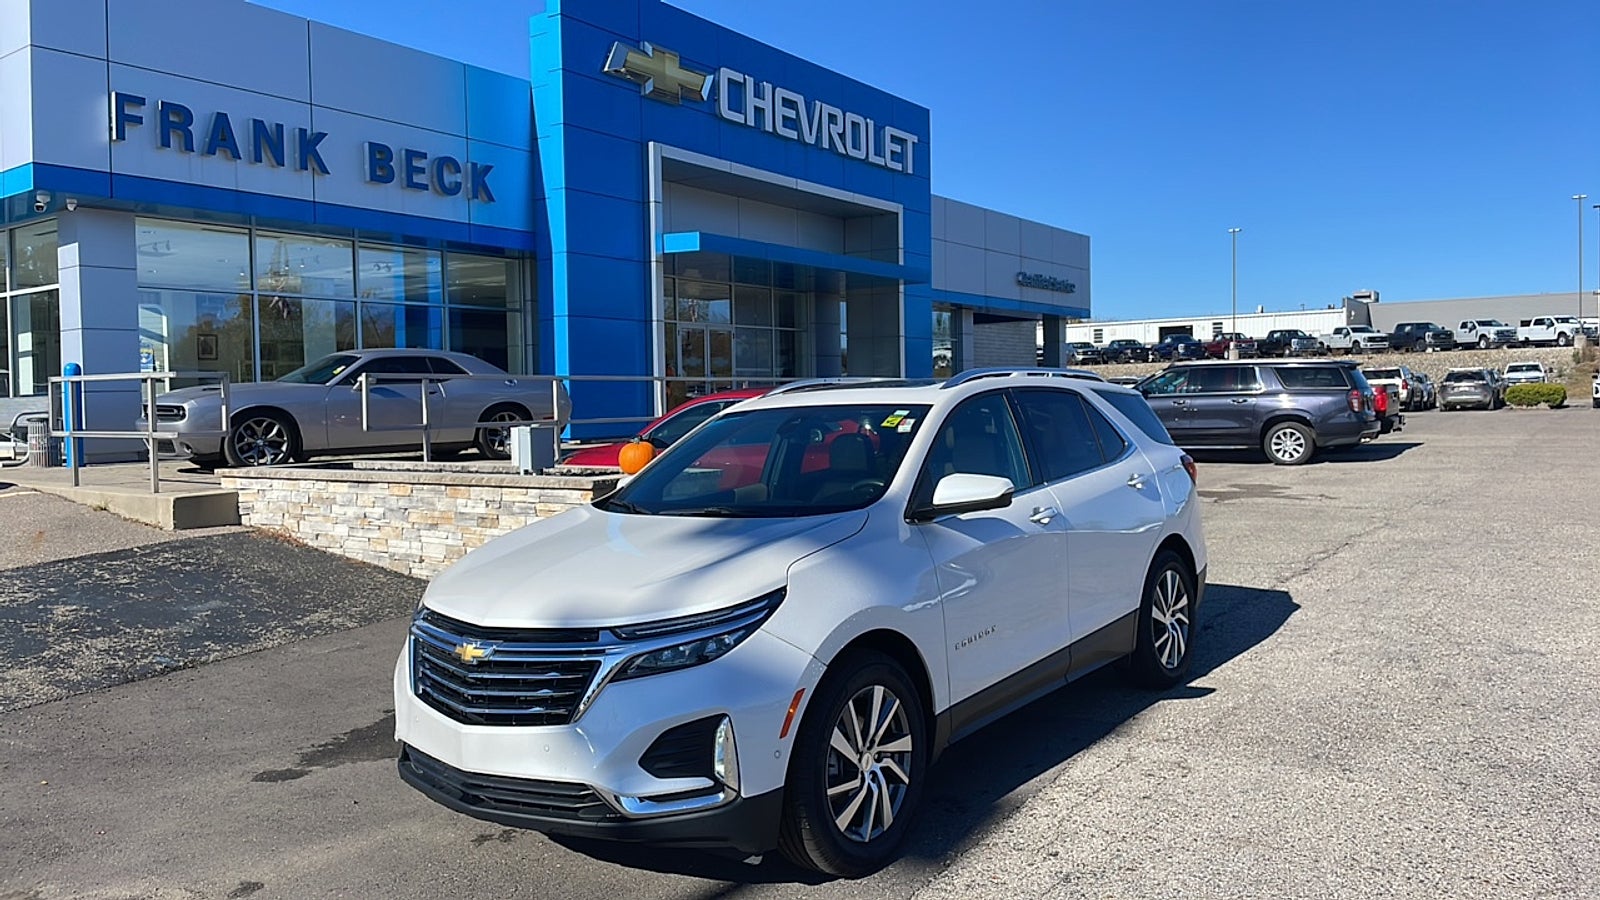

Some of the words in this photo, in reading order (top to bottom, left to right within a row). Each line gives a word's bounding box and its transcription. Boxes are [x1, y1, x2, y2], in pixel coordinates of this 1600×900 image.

[111, 91, 331, 175] FRANK
[364, 141, 496, 202] BECK
[718, 67, 919, 174] CHEVROLET
